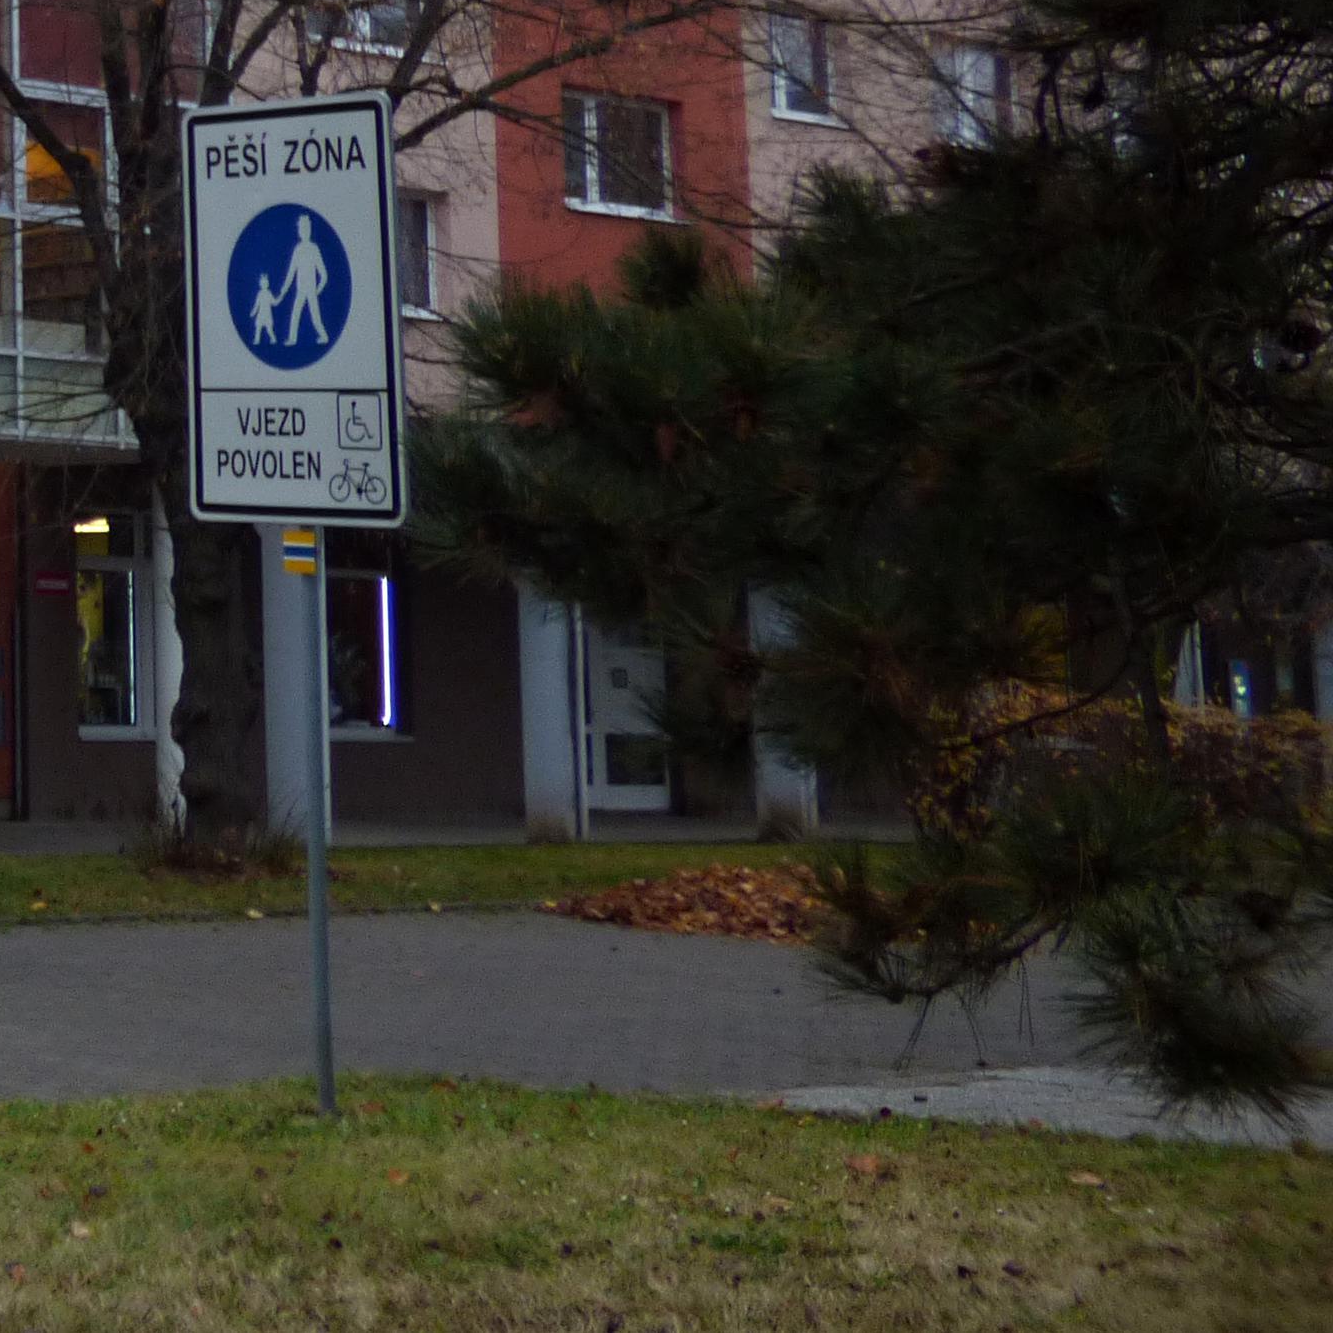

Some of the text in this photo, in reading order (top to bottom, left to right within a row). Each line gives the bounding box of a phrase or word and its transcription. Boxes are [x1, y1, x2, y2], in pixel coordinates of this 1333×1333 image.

[206, 128, 366, 179] PĚŠÍ ZÓNA
[237, 408, 306, 436] VJEZD
[217, 449, 321, 480] POVOLEN
